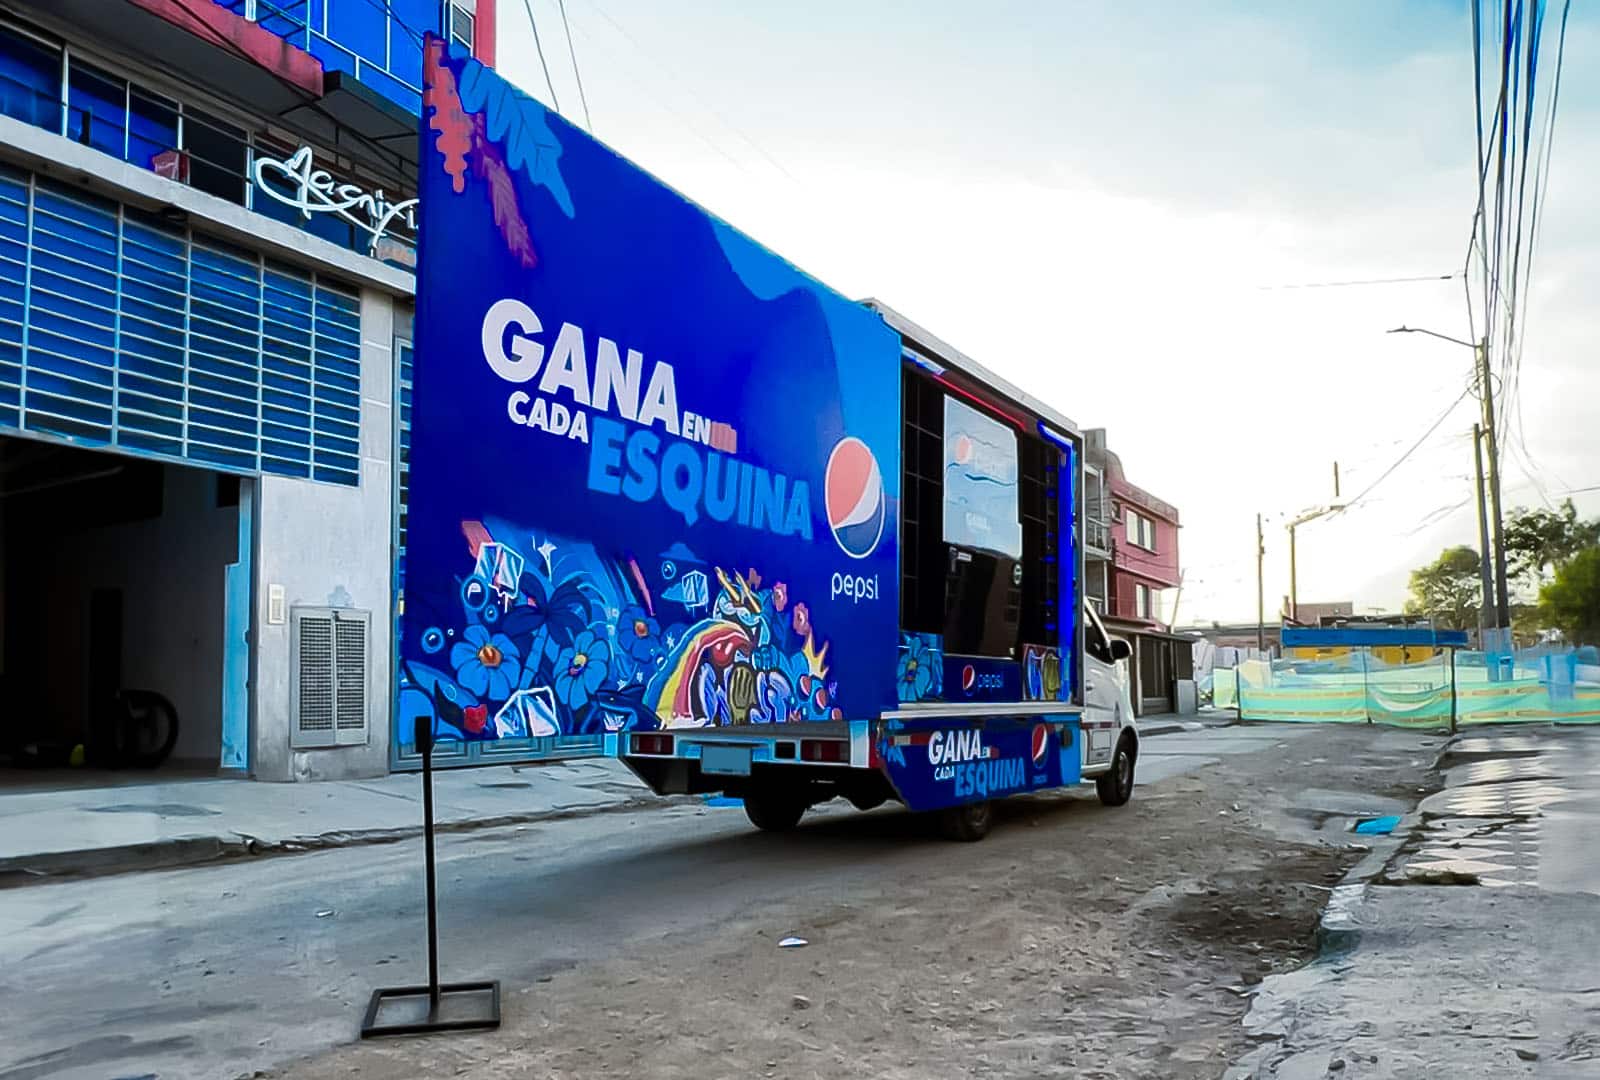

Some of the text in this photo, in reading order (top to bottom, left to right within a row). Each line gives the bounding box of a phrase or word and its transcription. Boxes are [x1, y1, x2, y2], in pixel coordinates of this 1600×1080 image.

[482, 299, 711, 445] GANA EN
[507, 391, 813, 540] CADA ESQUINA
[831, 572, 879, 604] pepsi
[929, 729, 981, 765] GANA
[955, 758, 1025, 797] ESQUINA
